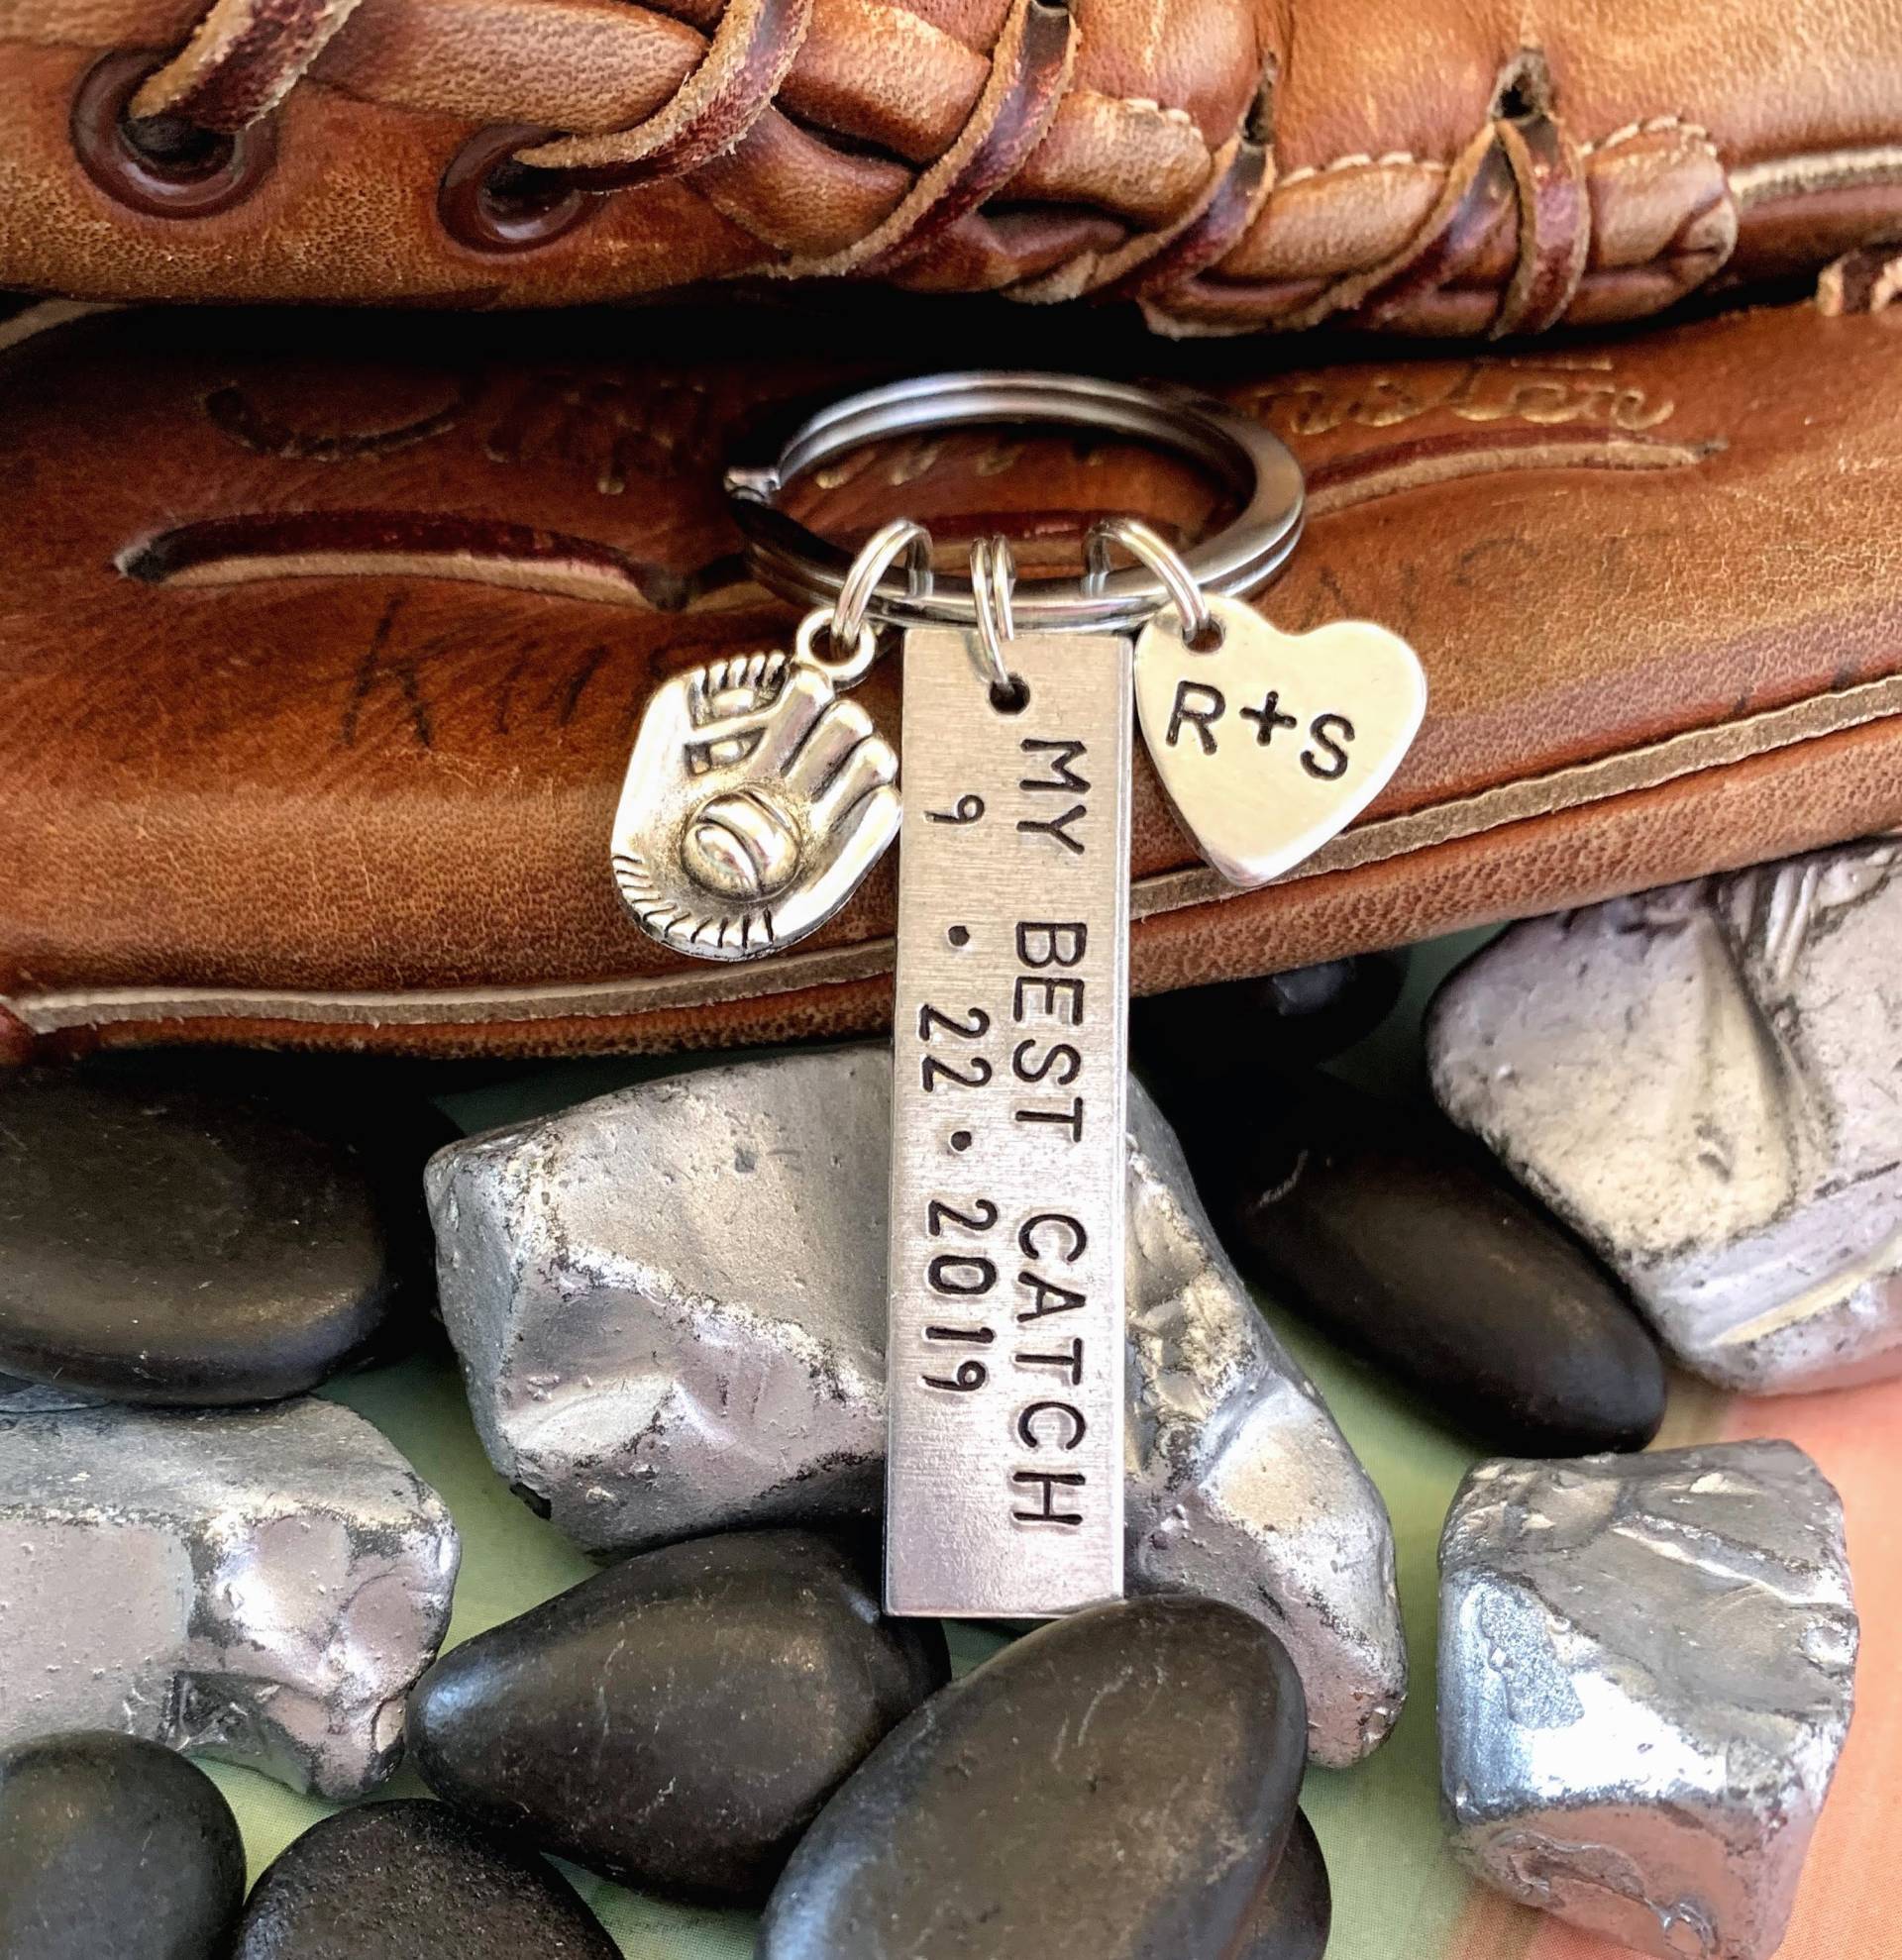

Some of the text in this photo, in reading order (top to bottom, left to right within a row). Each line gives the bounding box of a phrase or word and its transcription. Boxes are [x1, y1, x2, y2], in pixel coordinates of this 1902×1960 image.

[1012, 738, 1091, 1525] MY BEST CATCH
